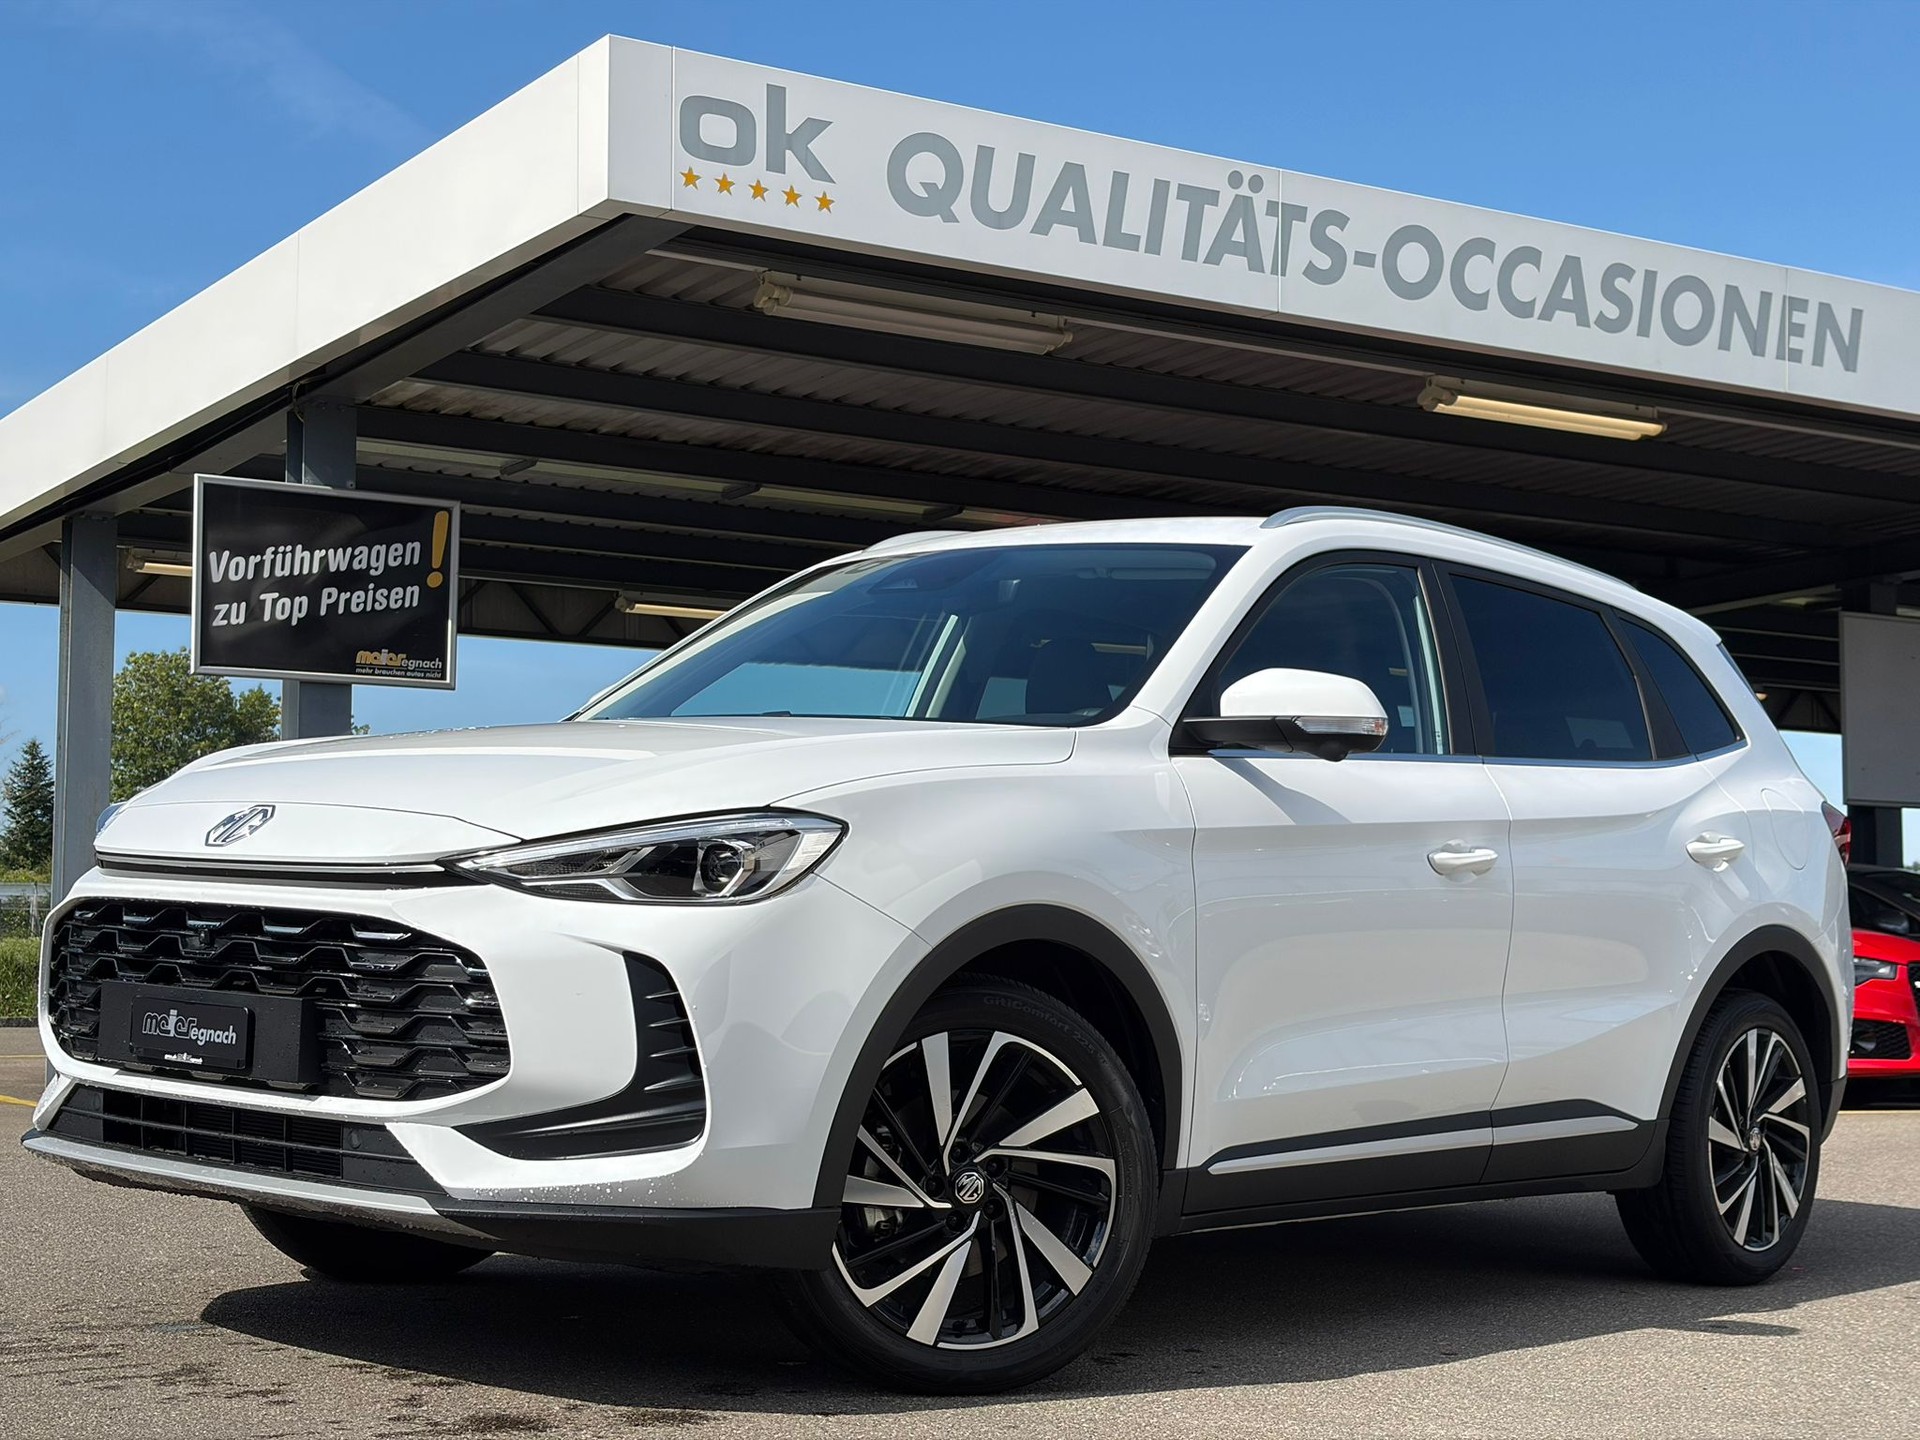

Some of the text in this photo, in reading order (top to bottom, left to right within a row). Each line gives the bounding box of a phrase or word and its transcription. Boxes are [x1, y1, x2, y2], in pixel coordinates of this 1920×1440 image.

[679, 83, 836, 184] ok
[886, 131, 1864, 374] QUALITÄTS-OCCASIONEN
[209, 540, 421, 583] Vorführwagen
[212, 582, 420, 627] zu Top Preisen
[375, 668, 405, 676] brauchen
[425, 671, 442, 679] nicht
[957, 1174, 982, 1201] MG
